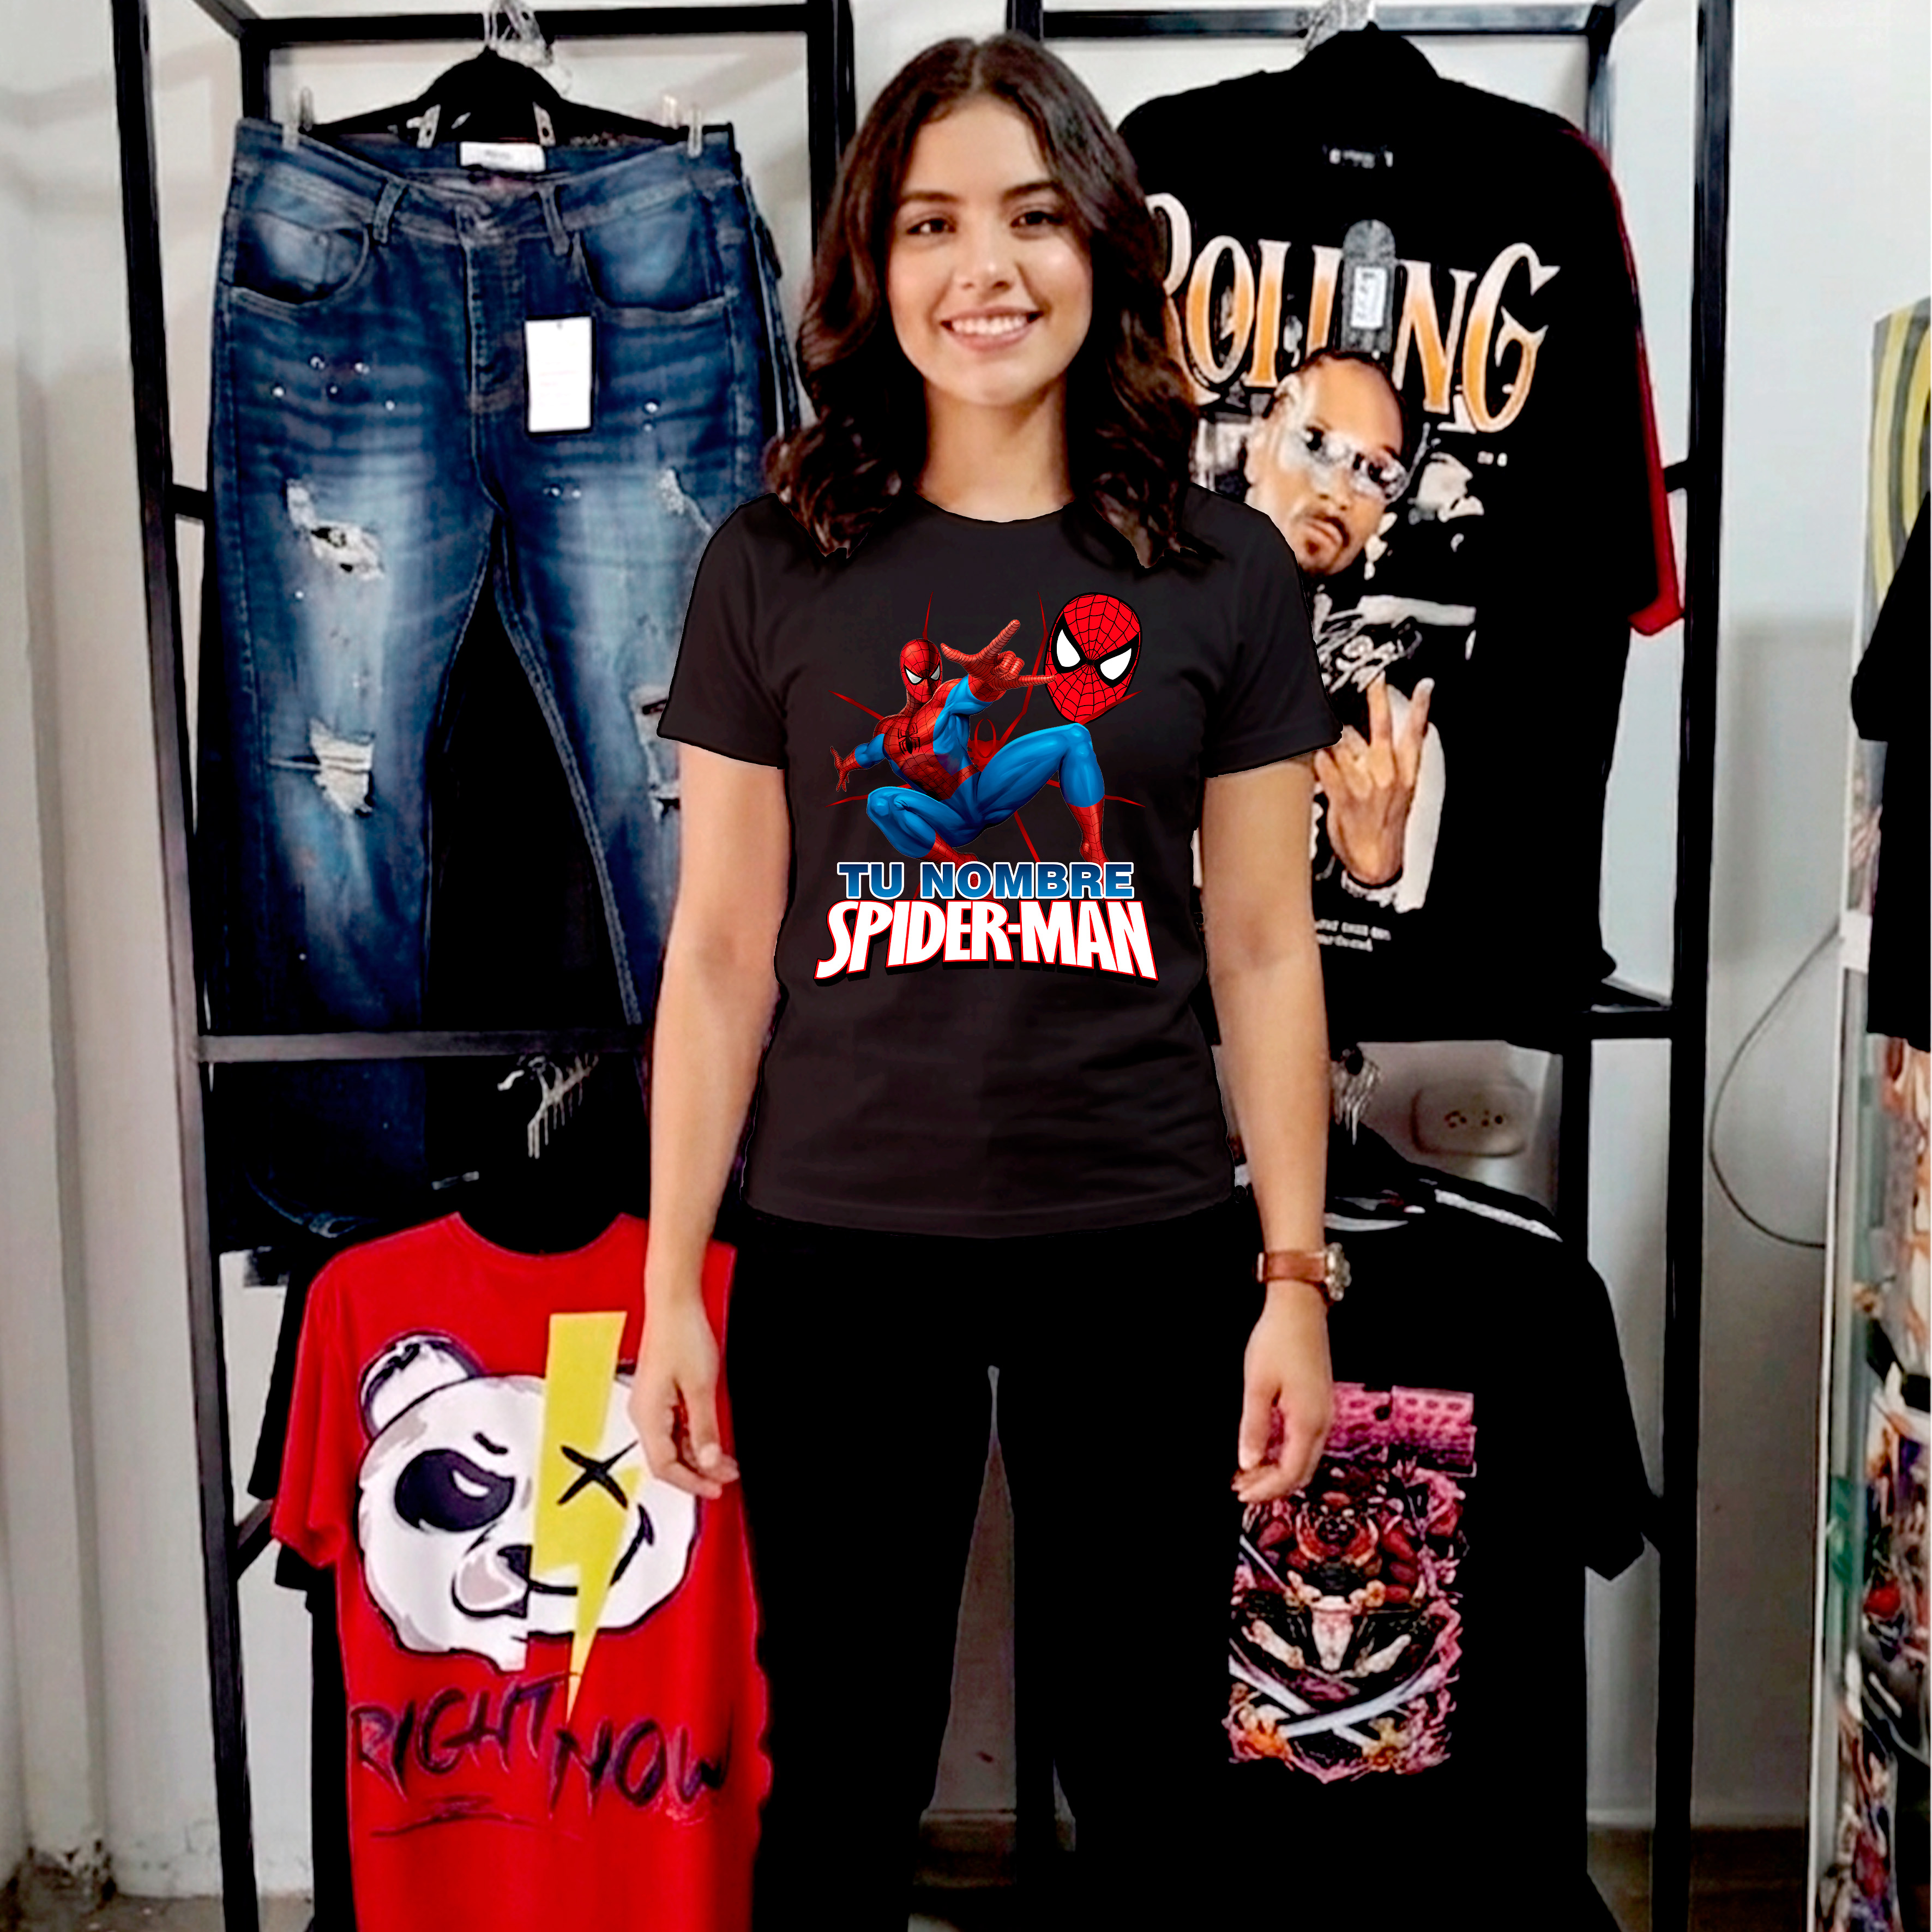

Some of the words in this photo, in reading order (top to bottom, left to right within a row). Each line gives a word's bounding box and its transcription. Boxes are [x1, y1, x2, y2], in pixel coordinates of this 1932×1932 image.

[837, 862, 905, 900] TU
[919, 862, 1135, 900] NOMBRE
[814, 900, 1159, 982] SPIDER-MAN
[351, 1672, 579, 1802] RIGHT
[548, 1707, 735, 1819] NOW
